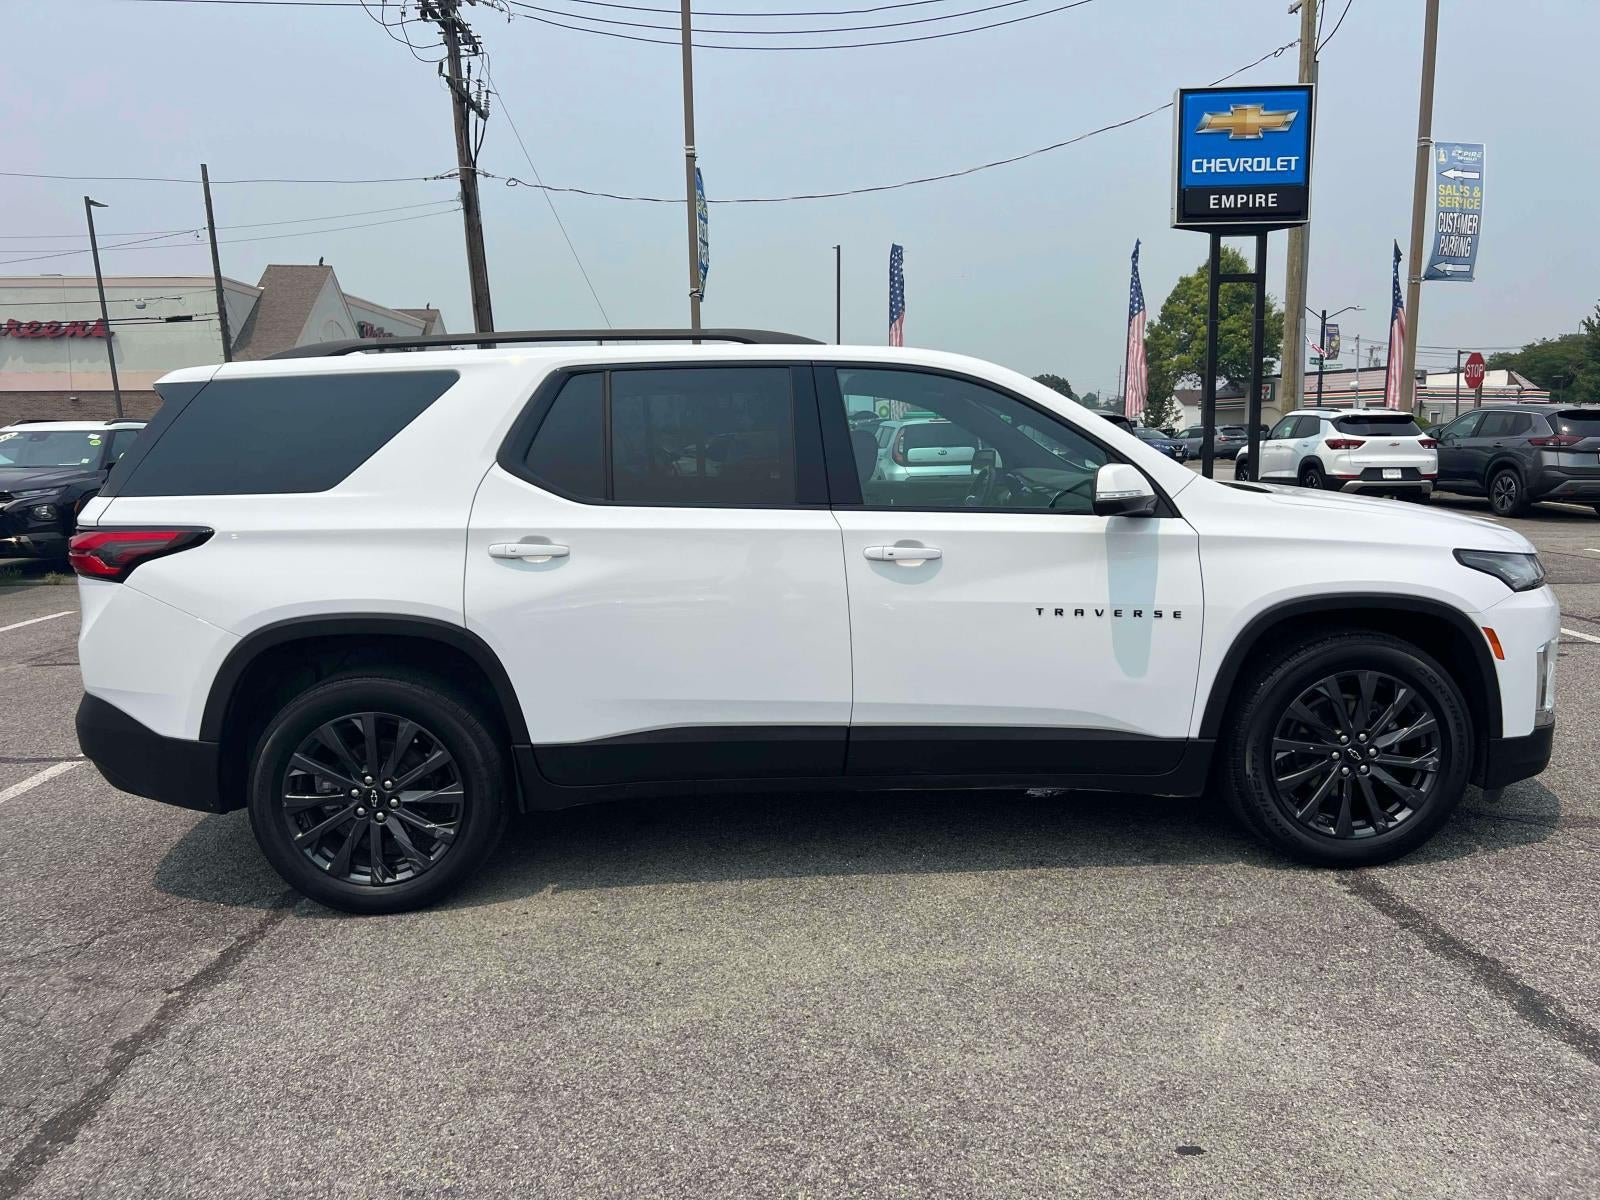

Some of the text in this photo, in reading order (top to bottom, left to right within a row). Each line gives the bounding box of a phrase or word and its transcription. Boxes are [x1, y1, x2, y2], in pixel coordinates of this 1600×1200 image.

[1452, 150, 1482, 158] EPIRE
[1191, 156, 1300, 174] CHEVROLET
[1473, 186, 1482, 198] &
[1209, 193, 1278, 209] EMPIRE
[1465, 363, 1483, 378] STOP
[1035, 607, 1182, 619] TRAVERSE
